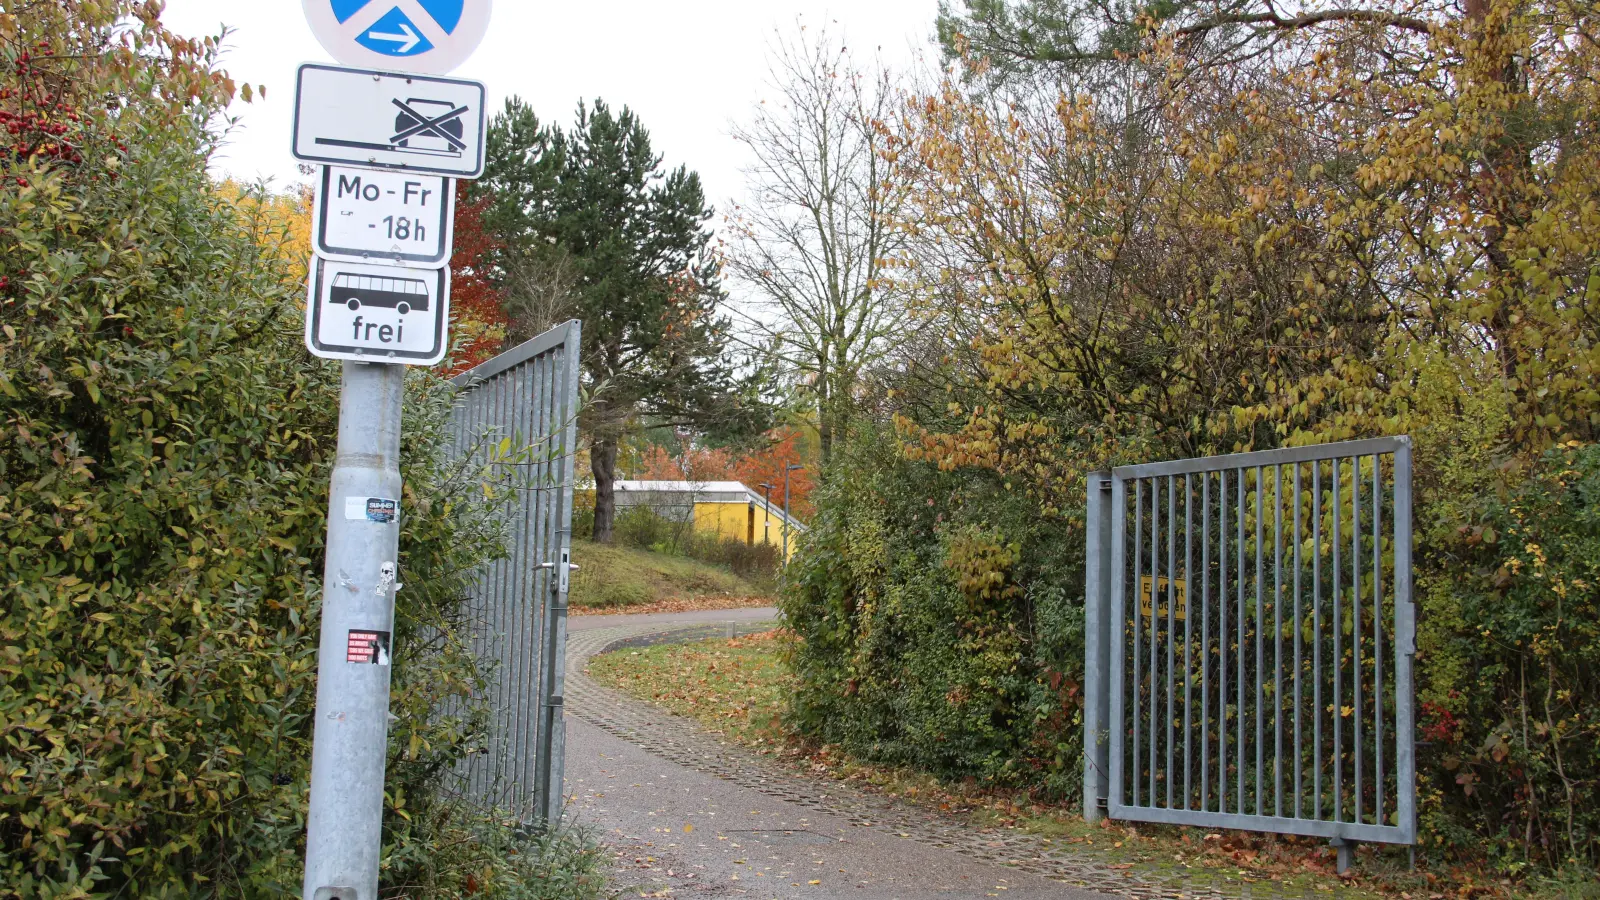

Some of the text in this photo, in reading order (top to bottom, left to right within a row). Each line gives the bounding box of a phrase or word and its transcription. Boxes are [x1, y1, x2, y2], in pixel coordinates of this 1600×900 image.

[337, 174, 380, 201] Mo
[403, 181, 432, 206] Fr
[352, 315, 404, 343] frei
[1142, 600, 1186, 612] veboen
